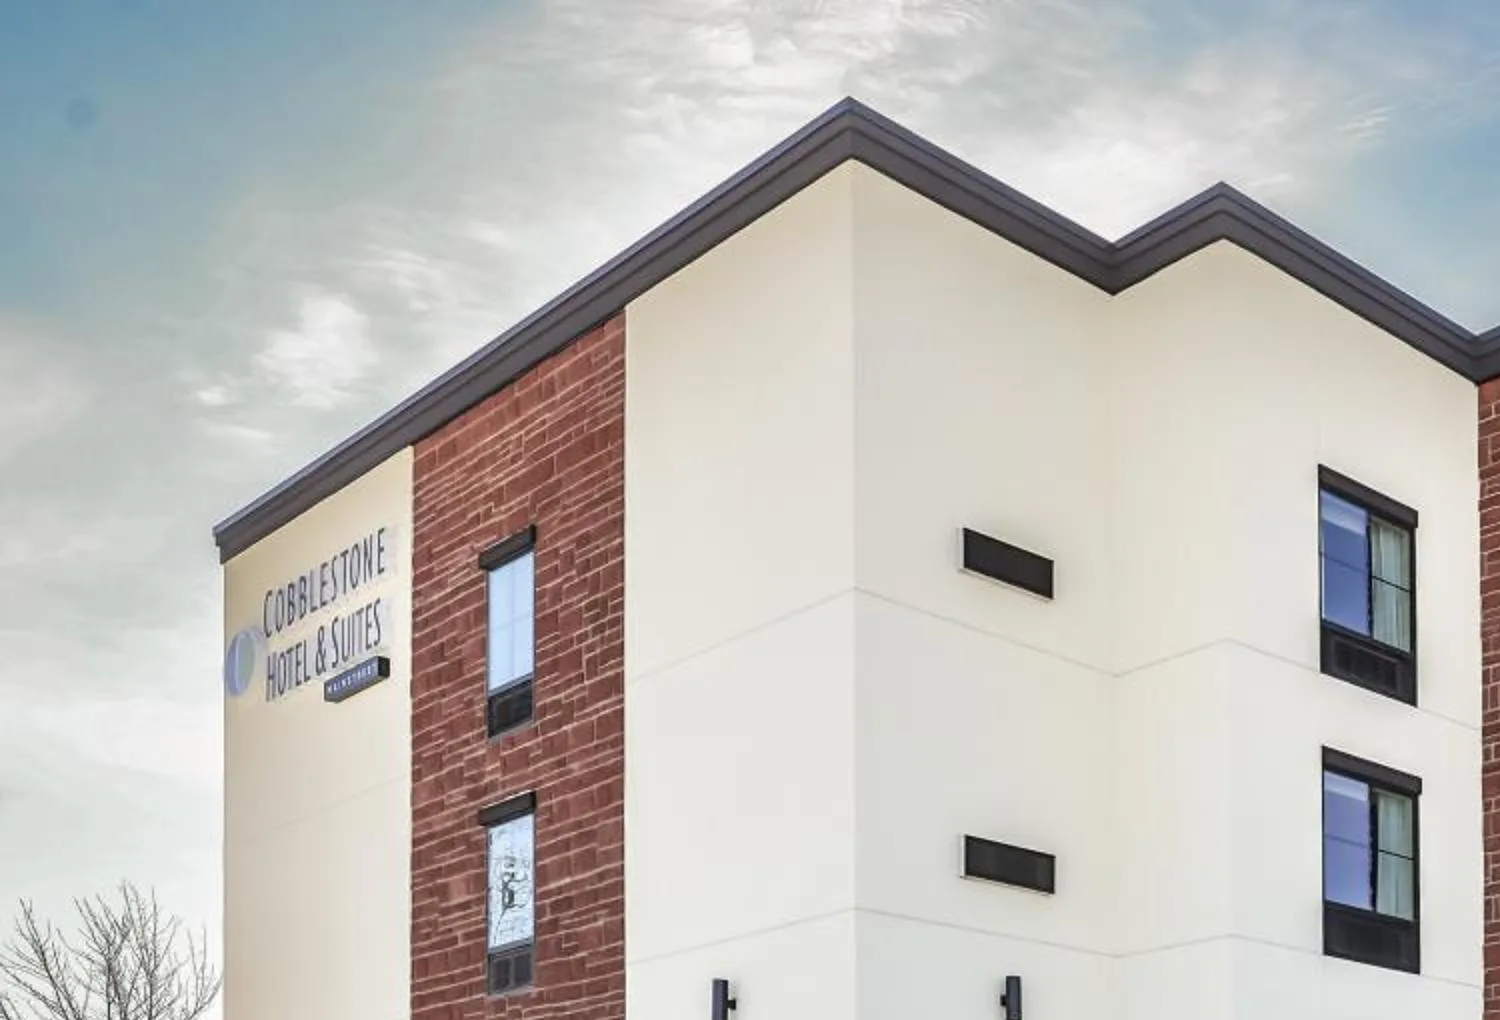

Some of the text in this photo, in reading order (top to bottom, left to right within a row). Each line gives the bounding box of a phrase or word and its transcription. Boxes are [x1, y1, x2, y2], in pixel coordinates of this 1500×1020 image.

[263, 527, 385, 638] COBBLESTONE
[265, 597, 381, 701] HOTEL & SUITES
